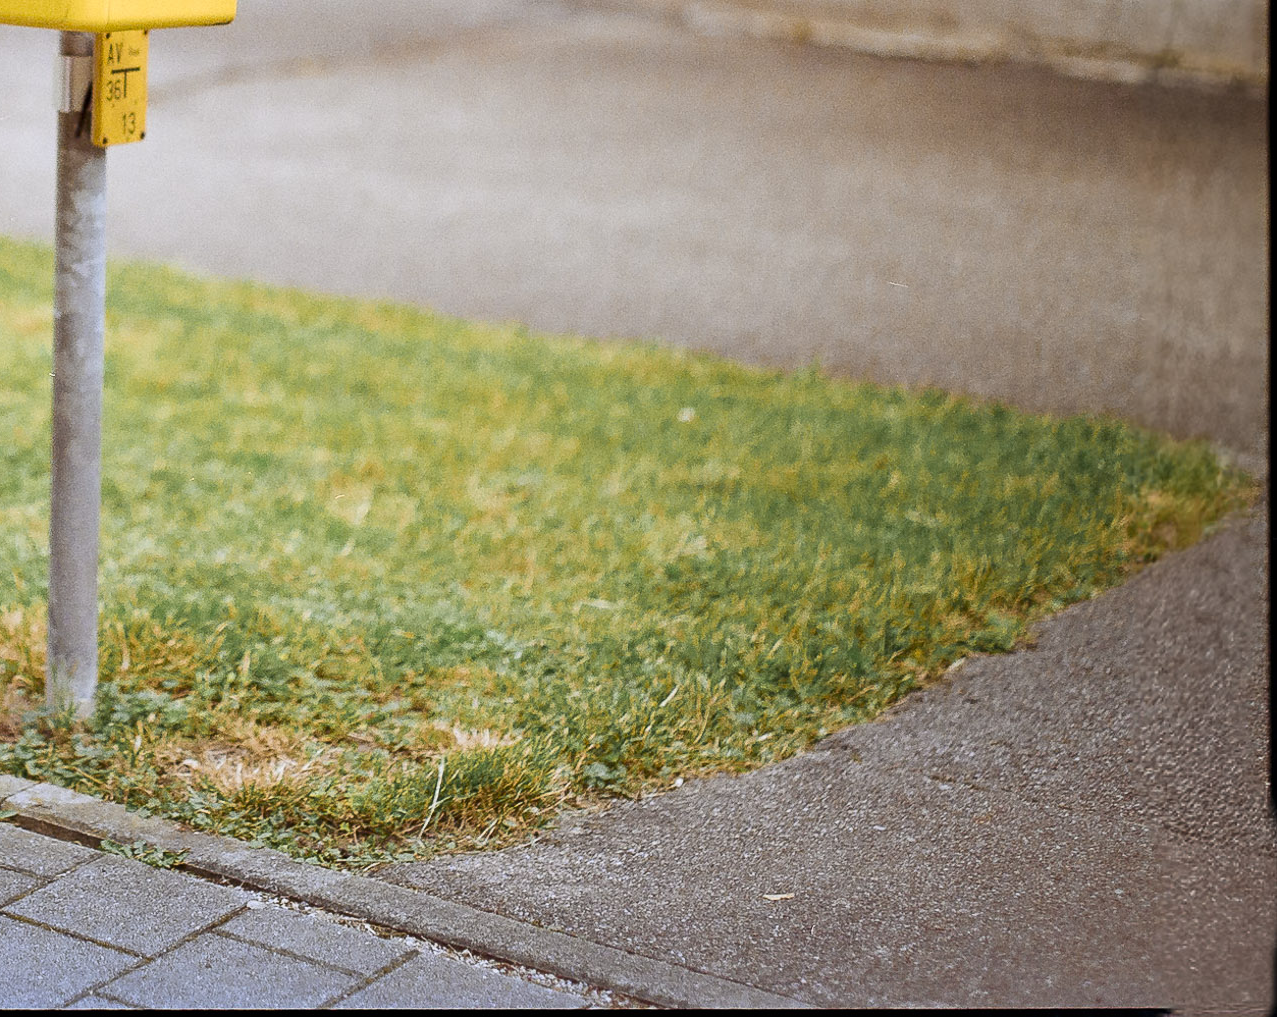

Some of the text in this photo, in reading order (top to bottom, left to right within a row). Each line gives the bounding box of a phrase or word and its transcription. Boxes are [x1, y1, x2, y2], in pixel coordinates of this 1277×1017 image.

[107, 42, 124, 64] AV
[106, 79, 122, 101] 36
[122, 112, 136, 135] 13
